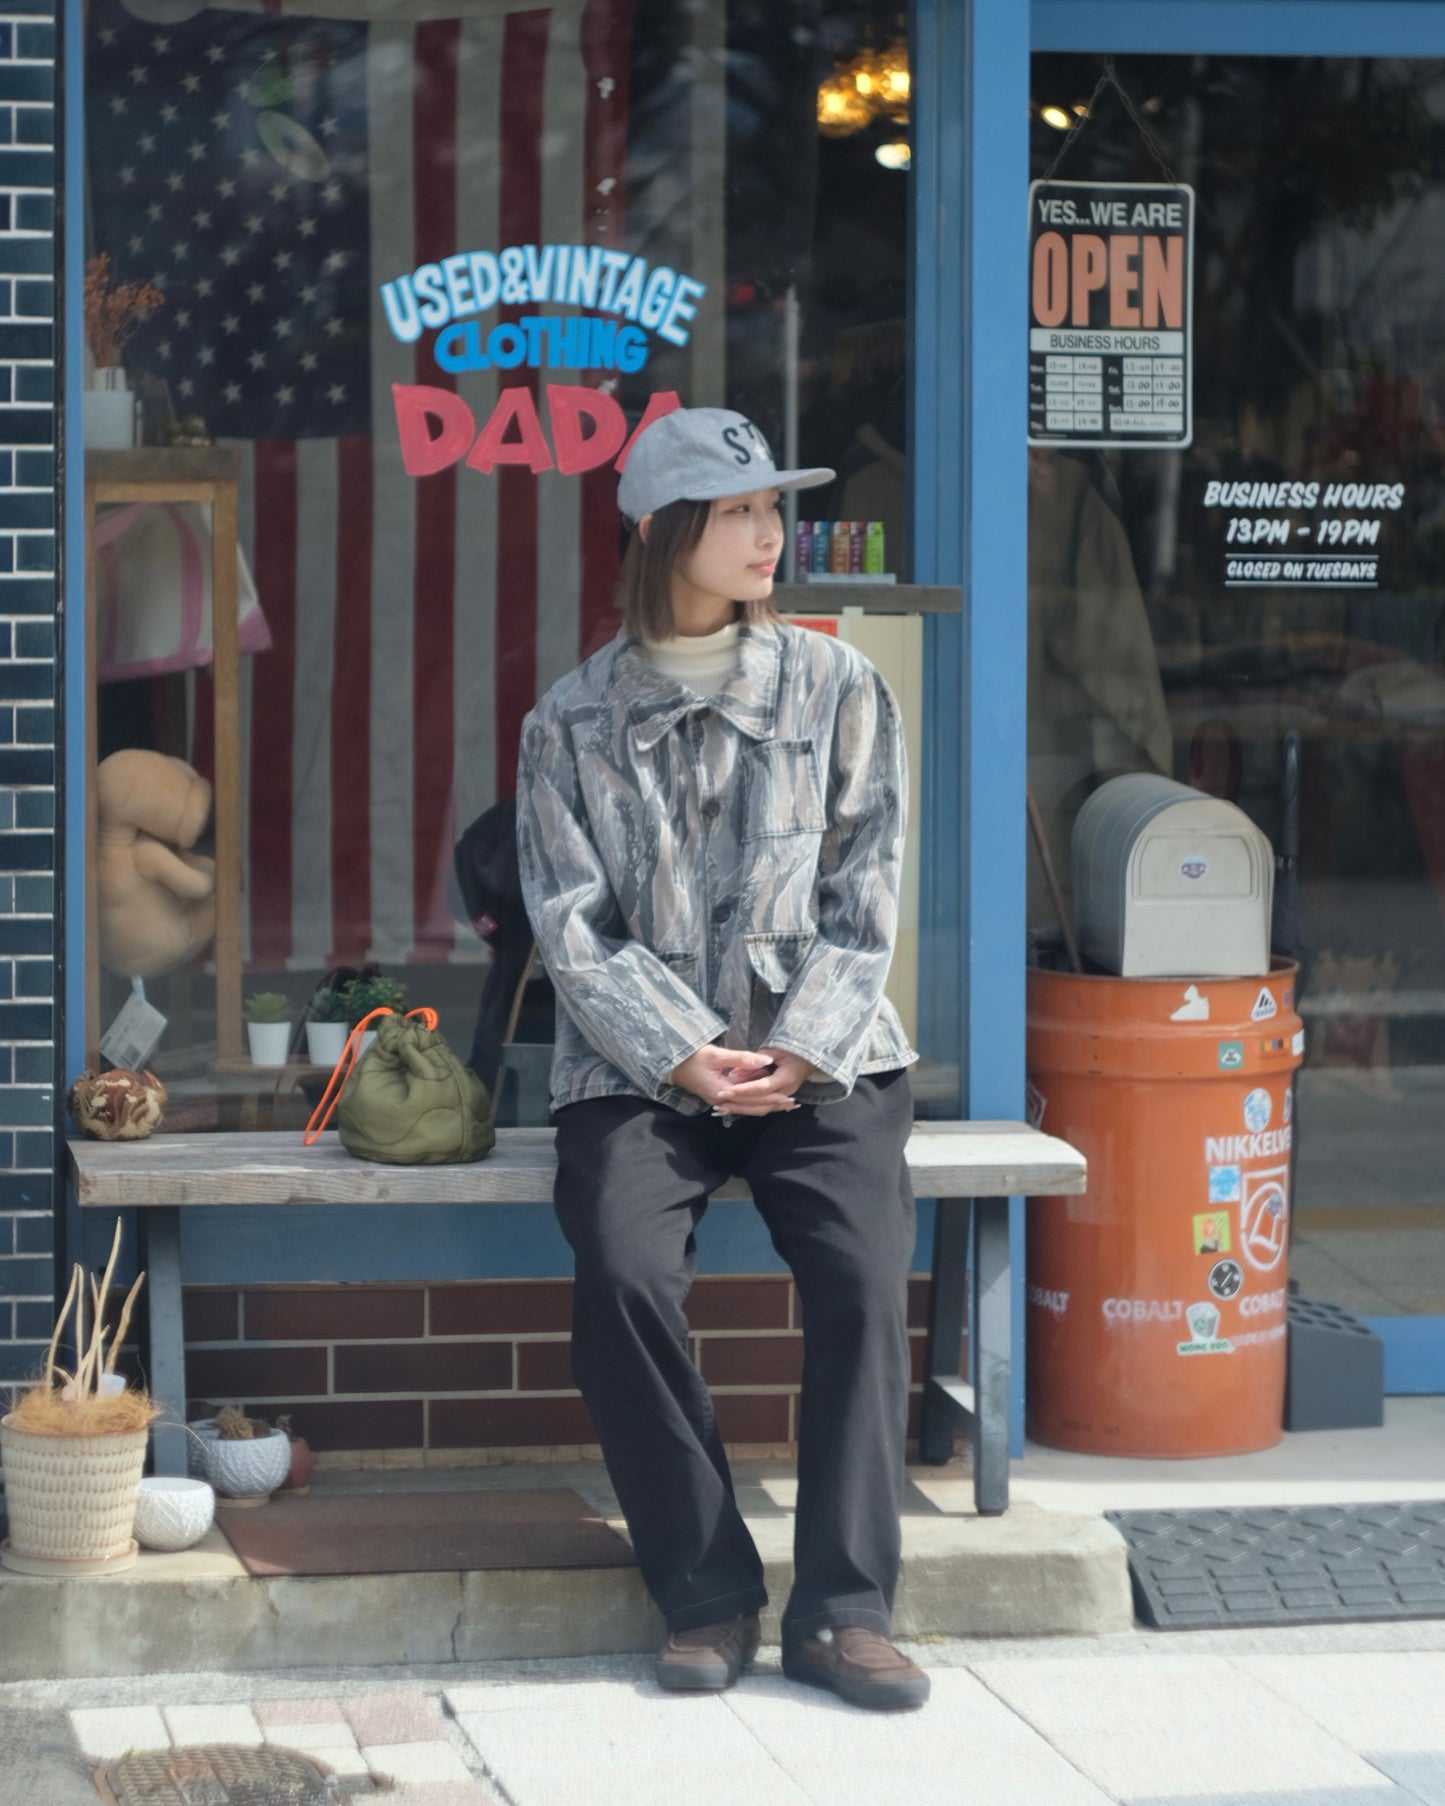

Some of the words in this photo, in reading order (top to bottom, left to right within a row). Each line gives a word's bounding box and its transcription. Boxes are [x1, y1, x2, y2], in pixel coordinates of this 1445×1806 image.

[1131, 203, 1183, 227] ARE
[1032, 230, 1184, 328] OPEN
[380, 244, 706, 346] USED&VINTAGE
[434, 317, 649, 373] CLOTHING
[1050, 334, 1111, 350] BUSINESS
[1114, 336, 1160, 350] HOURS
[1204, 481, 1320, 509] BUSINESS
[1323, 483, 1405, 510] HOURS
[1226, 517, 1290, 545] 13PM
[1316, 519, 1381, 545] 19PM
[1227, 561, 1281, 579] CLOSED
[1283, 562, 1304, 579] ON
[1306, 562, 1377, 579] TUESDAYS
[1102, 1298, 1183, 1321] COBALT
